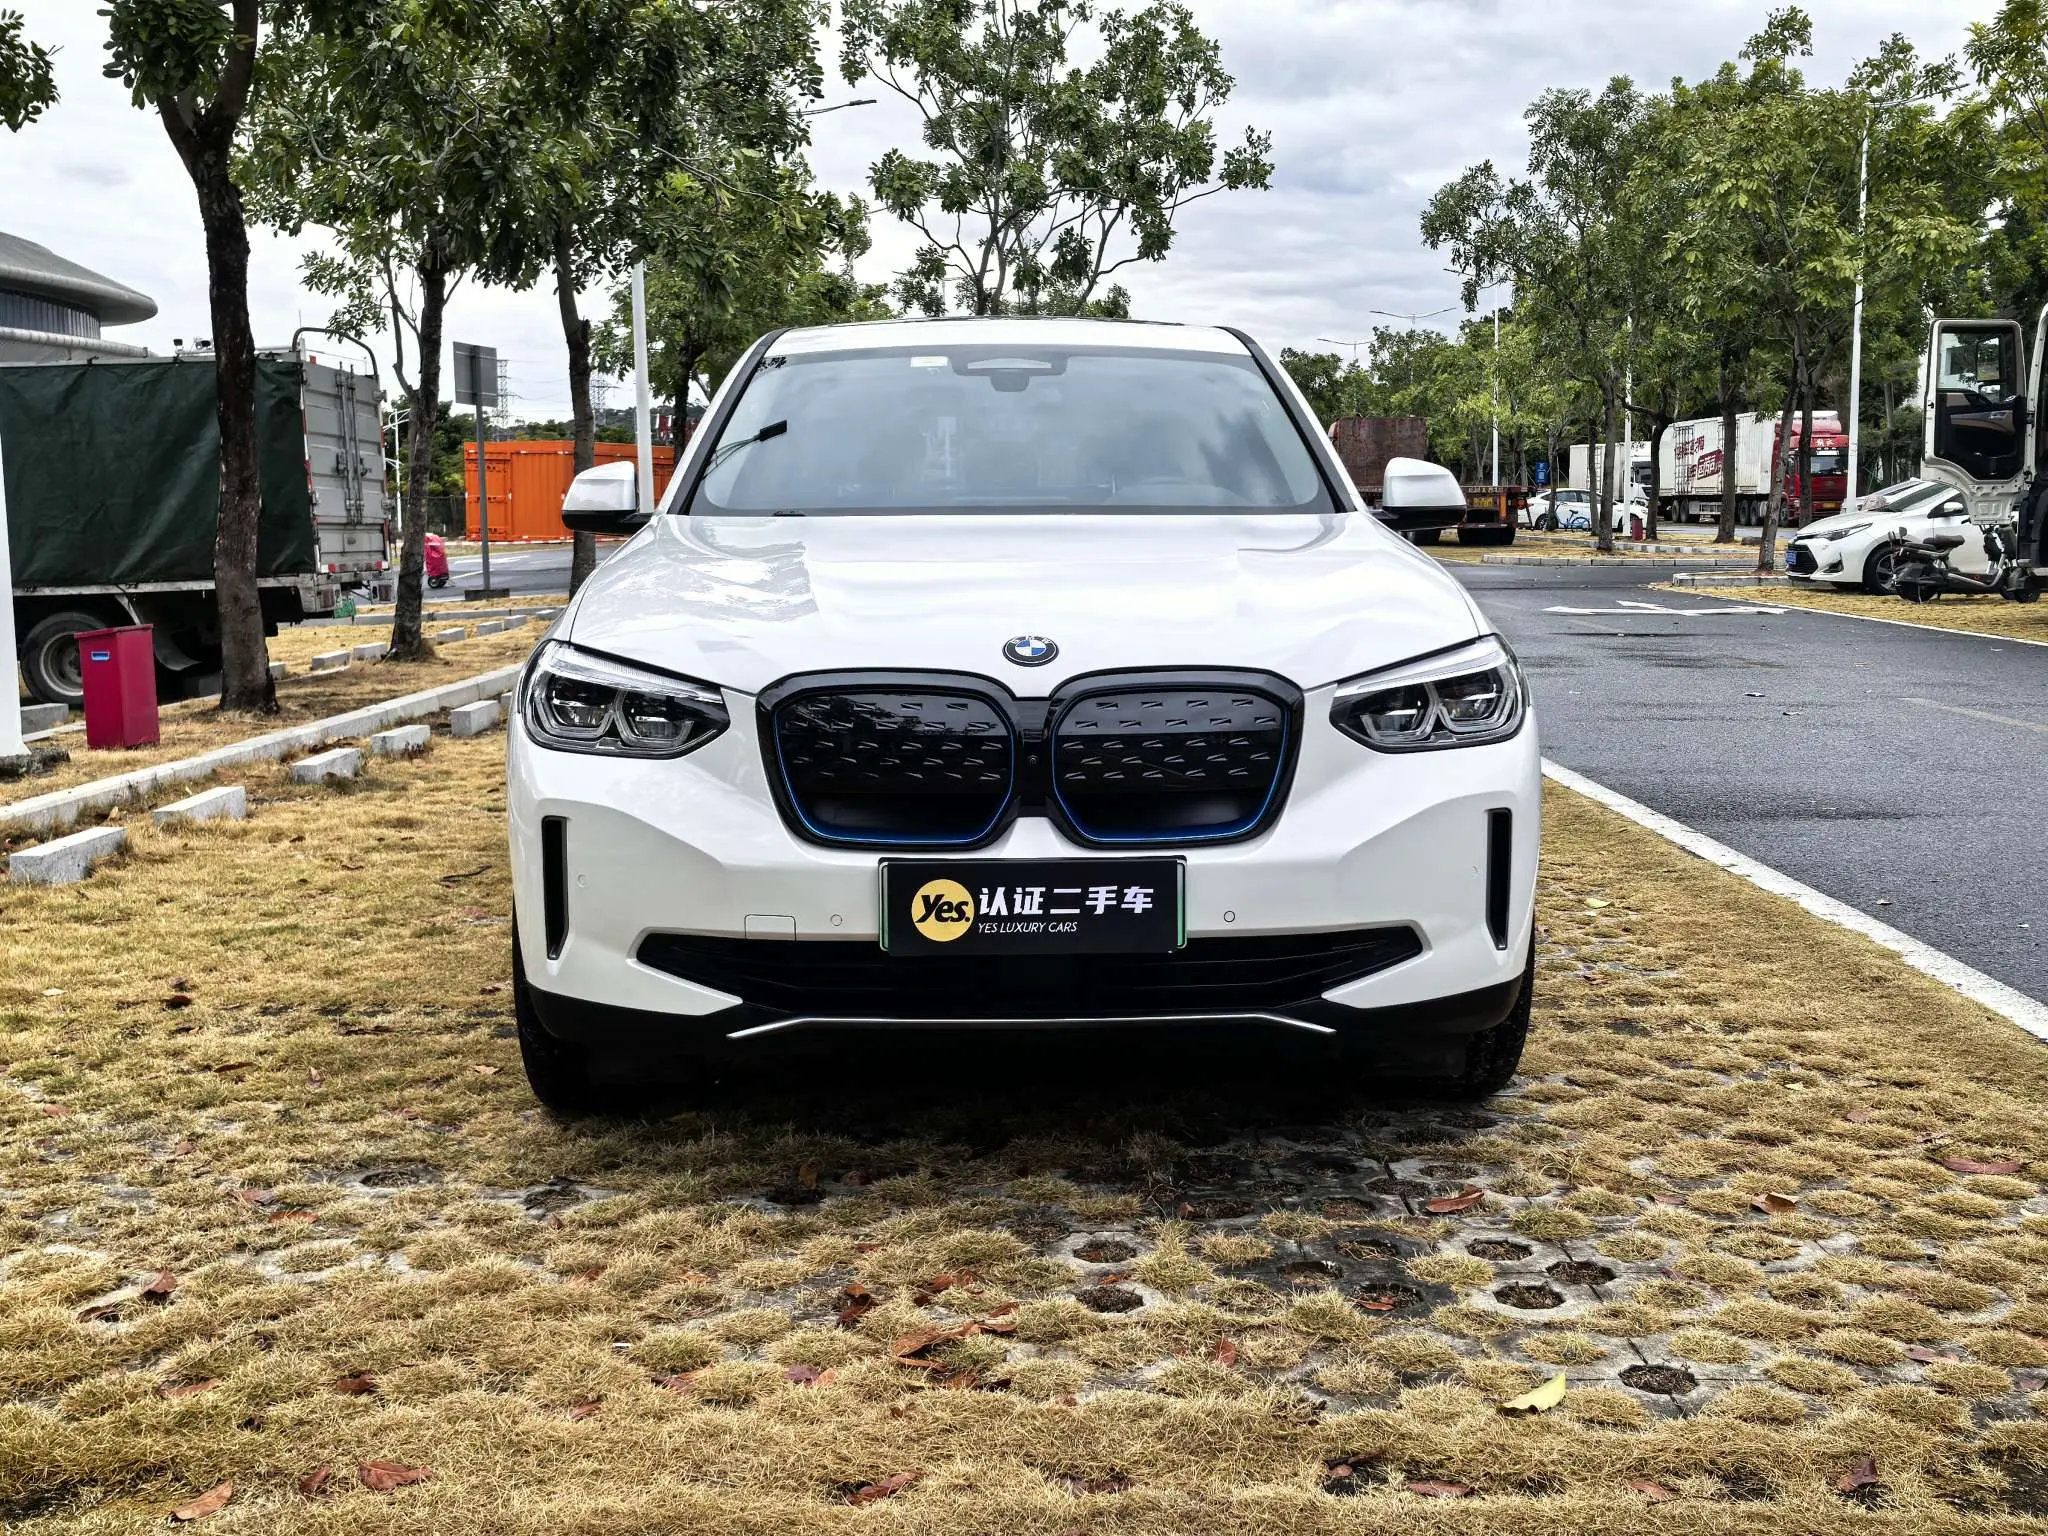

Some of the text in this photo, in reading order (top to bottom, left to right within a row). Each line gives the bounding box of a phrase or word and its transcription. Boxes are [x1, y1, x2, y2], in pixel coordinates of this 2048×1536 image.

[979, 886, 1154, 916] 认证二手车
[978, 921, 1078, 933] YES LUXURY CARS
